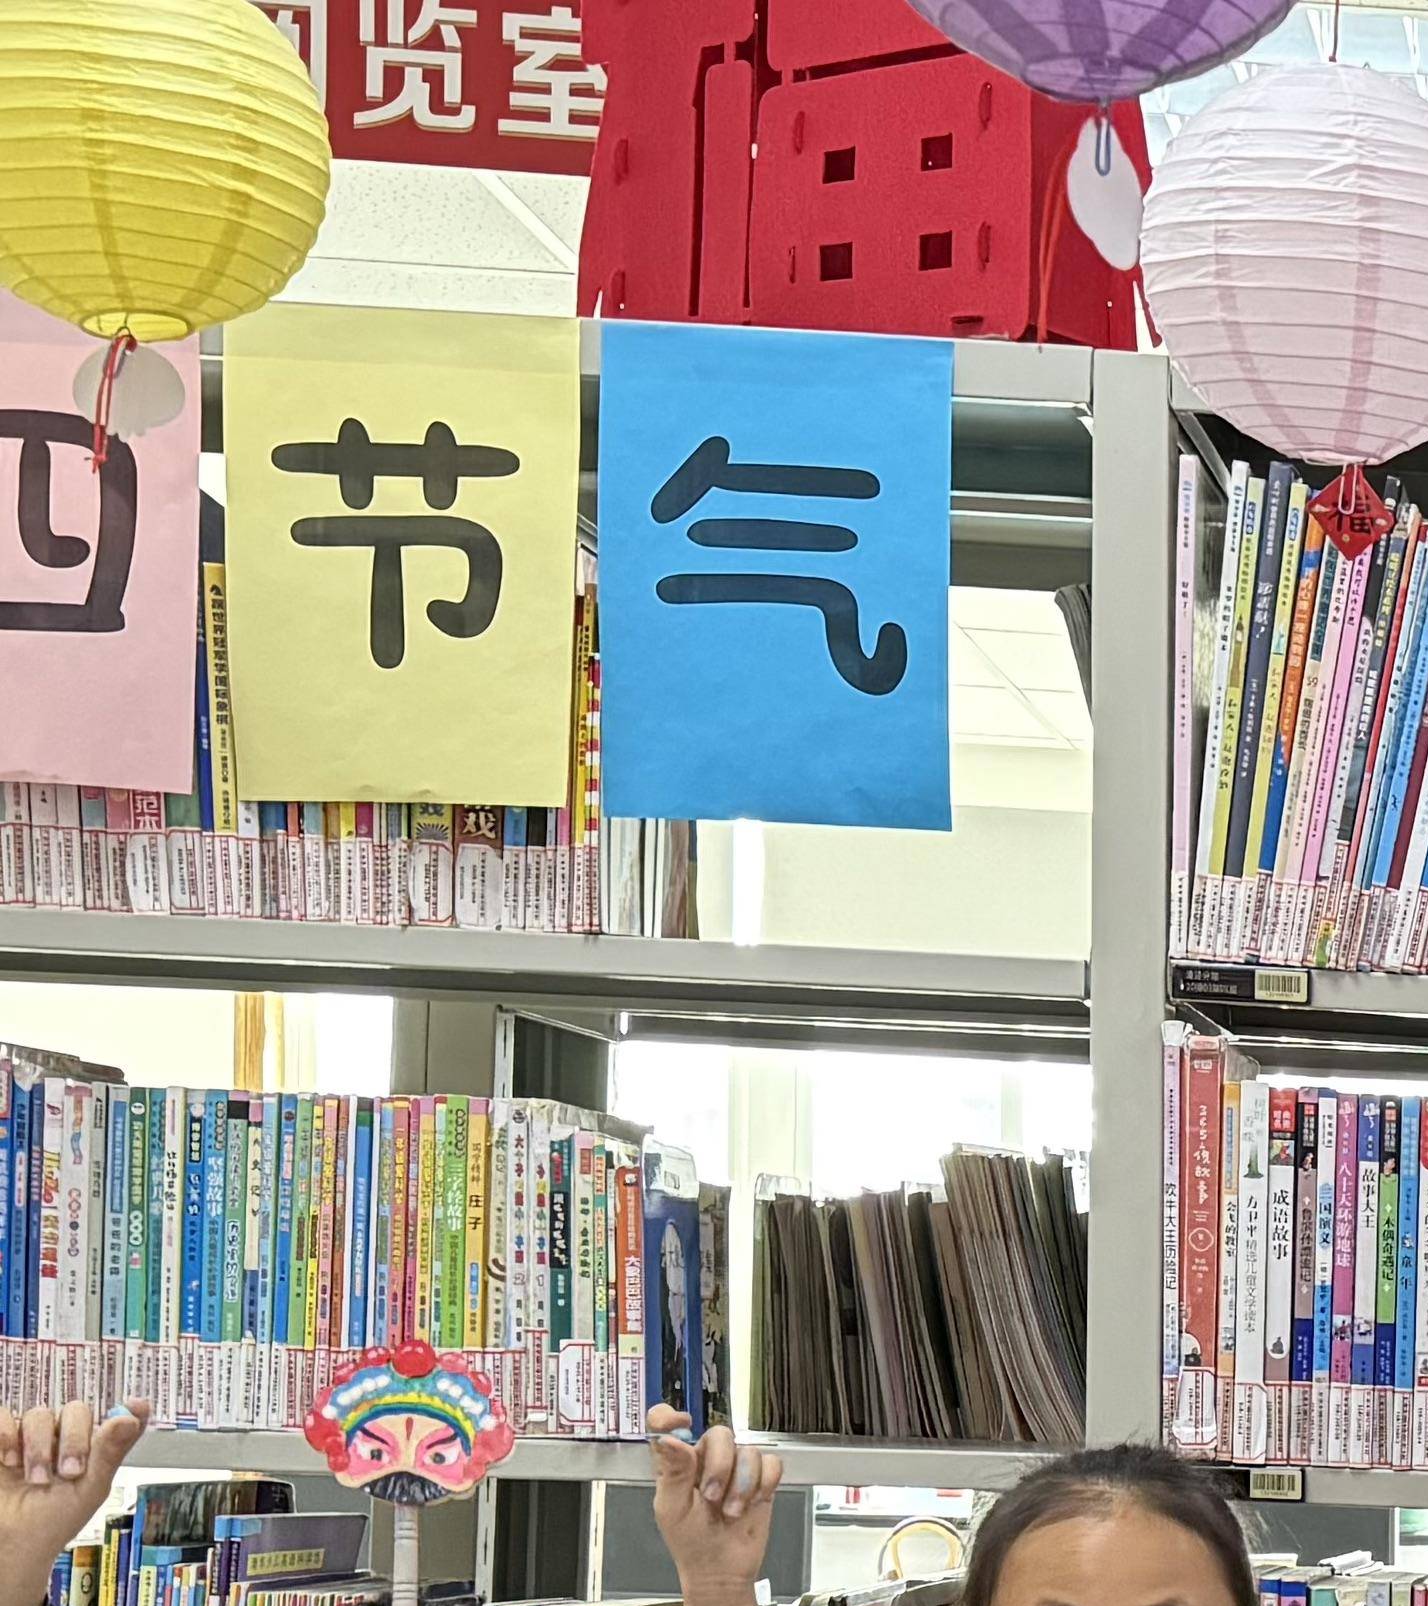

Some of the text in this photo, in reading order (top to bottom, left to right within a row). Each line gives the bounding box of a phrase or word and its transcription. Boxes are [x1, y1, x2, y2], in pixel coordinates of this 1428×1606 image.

[252, 0, 608, 142] 览室
[0, 408, 909, 696] 四 节 气
[462, 804, 497, 839] 戏
[468, 1193, 485, 1231] 庄子
[1271, 1188, 1291, 1260] 成语故事
[1336, 1161, 1353, 1269] 八十天环游地球
[1361, 1168, 1377, 1229] 故事大王
[1381, 1215, 1396, 1283] 木偶奇遇记
